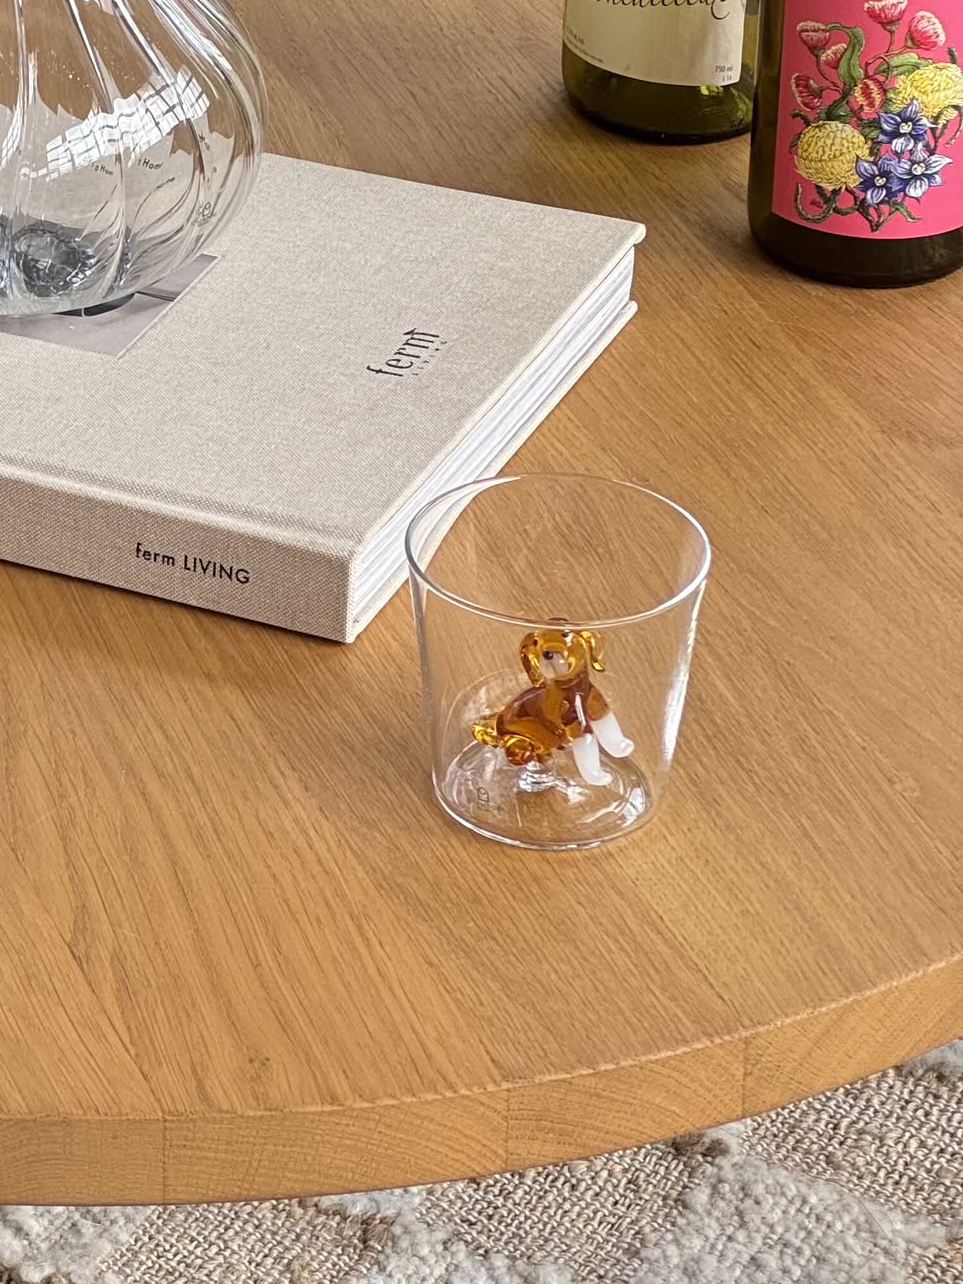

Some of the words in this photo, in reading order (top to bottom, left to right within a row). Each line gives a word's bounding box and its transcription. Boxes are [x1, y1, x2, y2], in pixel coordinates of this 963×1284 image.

[365, 327, 441, 378] ferm
[135, 542, 177, 567] ferm
[183, 554, 251, 586] LIVING
